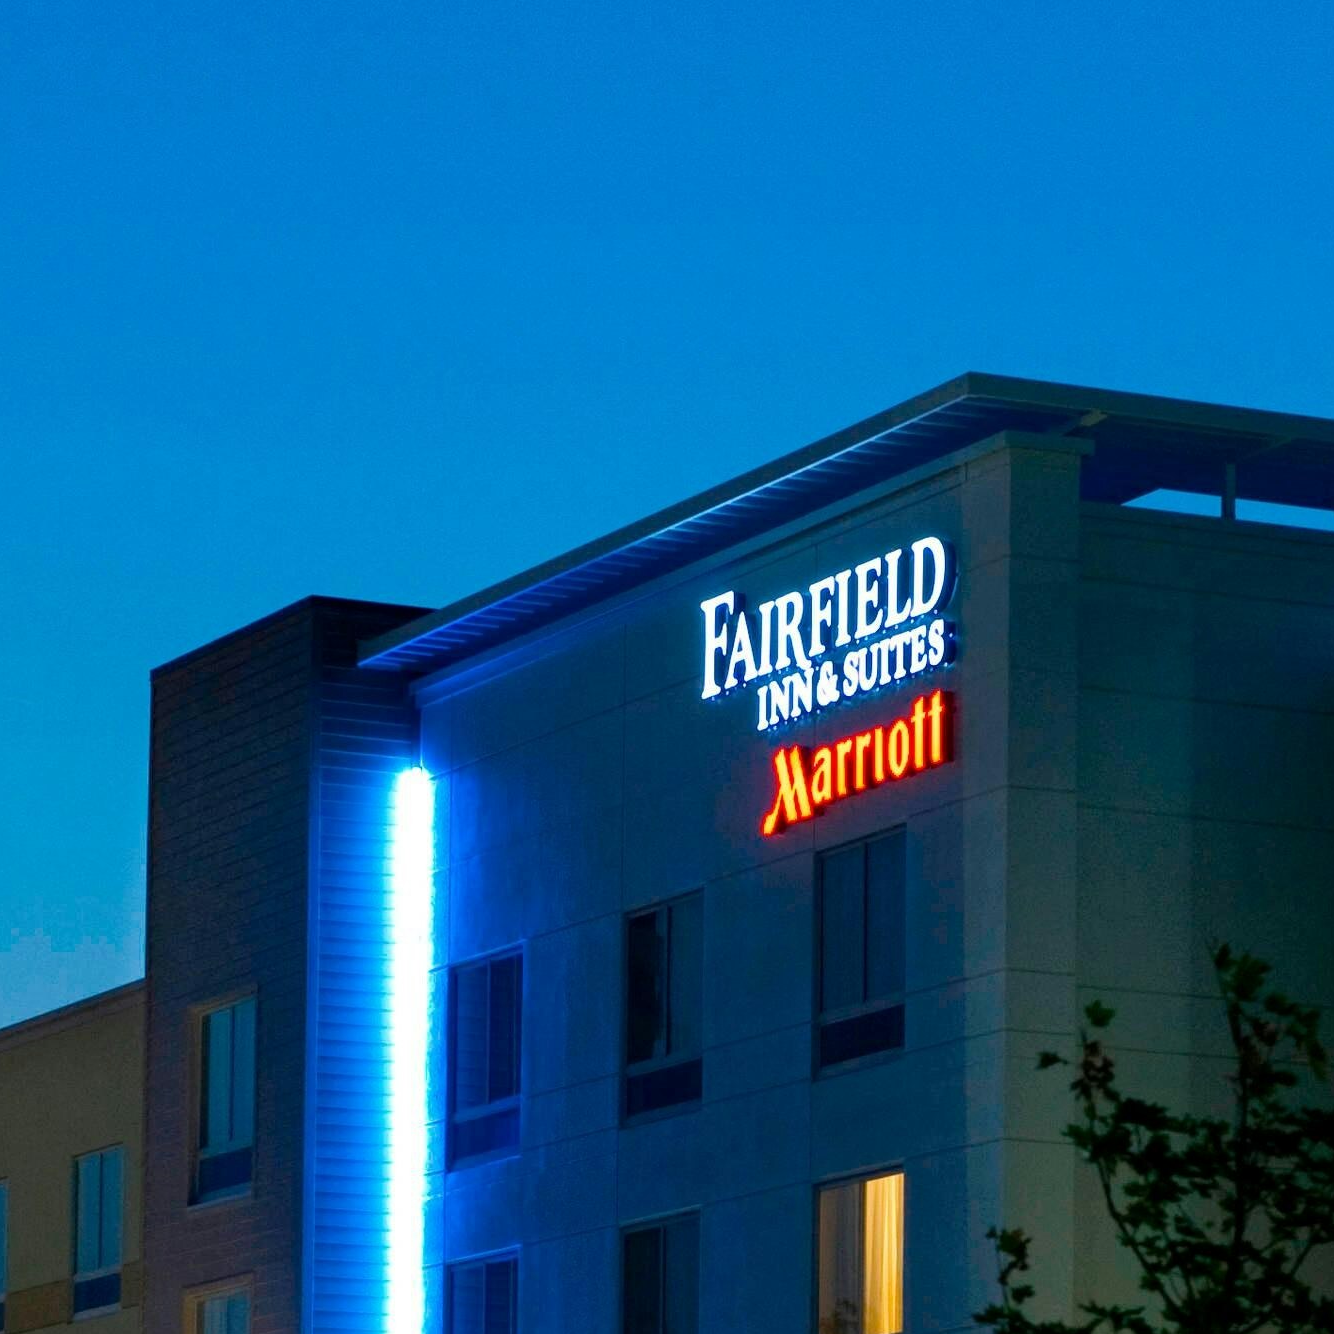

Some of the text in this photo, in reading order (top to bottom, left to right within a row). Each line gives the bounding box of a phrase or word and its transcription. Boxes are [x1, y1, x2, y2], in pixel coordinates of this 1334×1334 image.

[700, 536, 947, 700] FAIRFIELD
[842, 618, 945, 697] SUITES
[760, 688, 946, 835] Marriott
